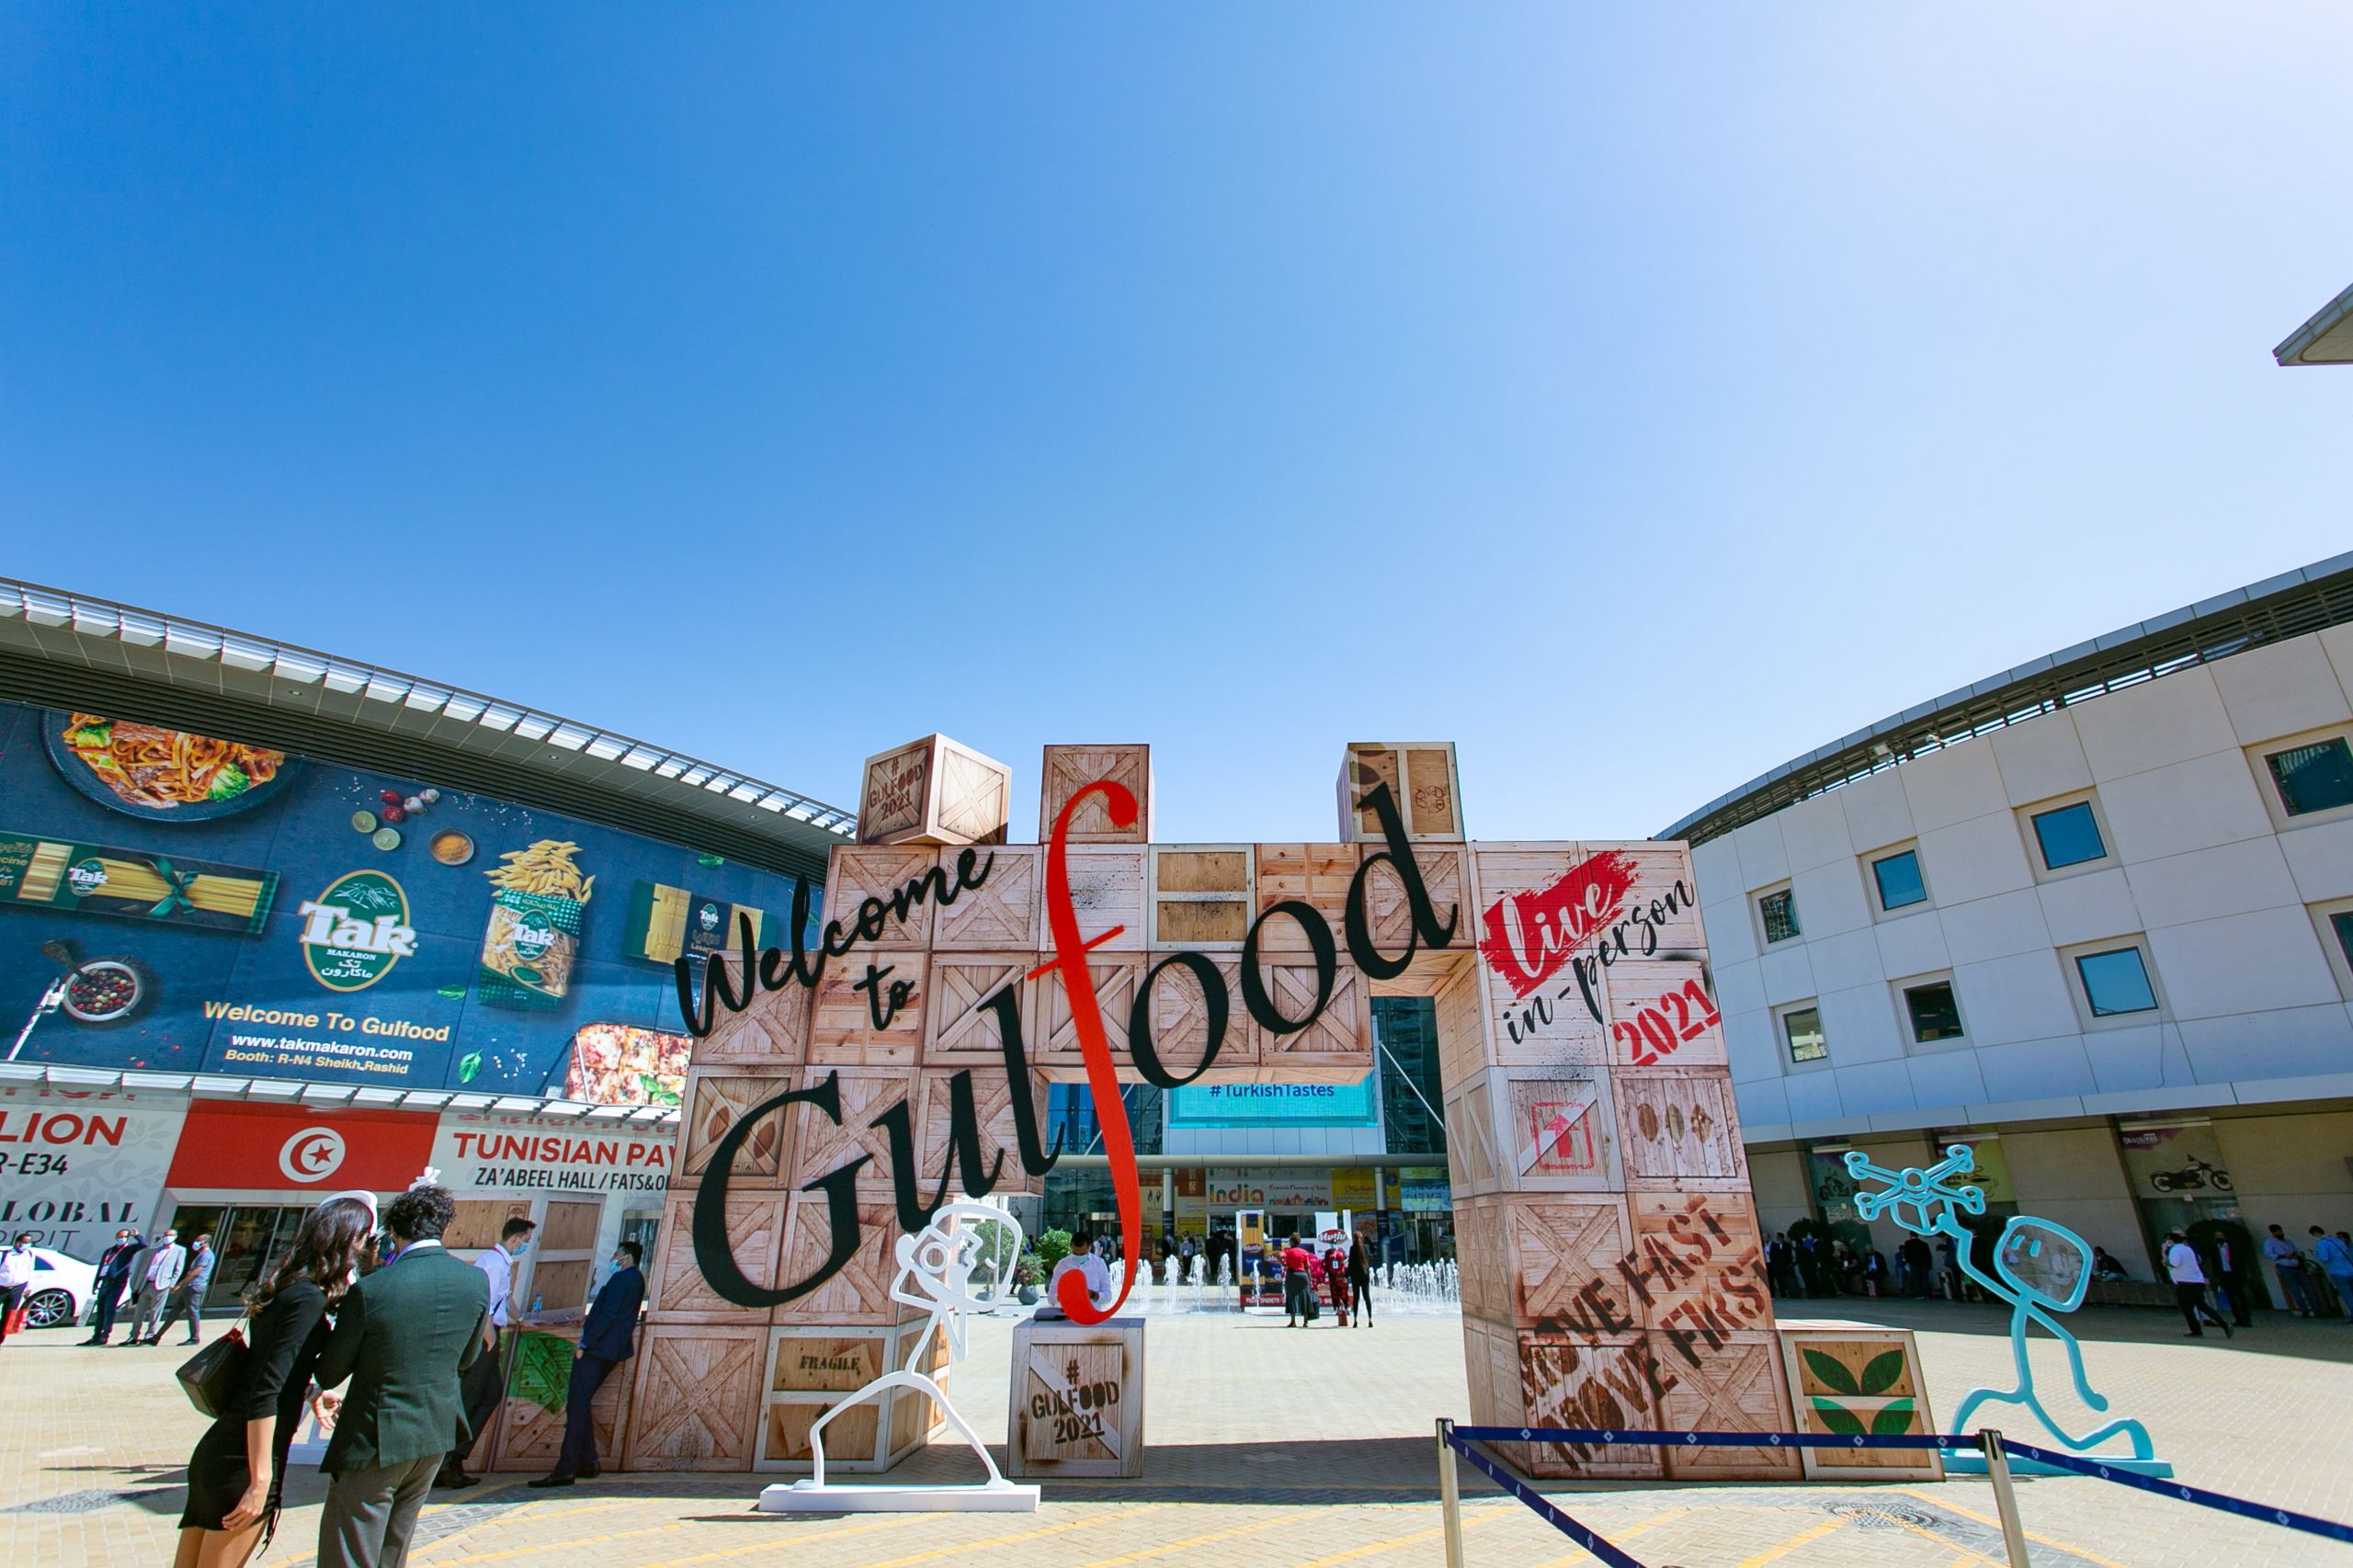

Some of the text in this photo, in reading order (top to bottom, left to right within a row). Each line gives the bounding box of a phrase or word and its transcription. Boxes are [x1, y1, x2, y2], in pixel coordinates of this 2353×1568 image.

[881, 789, 912, 821] 2021
[68, 867, 108, 884] Tak
[298, 901, 419, 957] Tak
[699, 910, 719, 924] Tak
[511, 923, 555, 946] Tak
[675, 847, 995, 1038] Welcome
[326, 949, 377, 960] MAKARON
[1503, 879, 1695, 1045] in-person
[853, 964, 915, 1030] to
[203, 1000, 450, 1042] Welcome To Gulfood
[1613, 978, 1721, 1066] 2021
[224, 1050, 408, 1074] Booth: R-N4 Sheikh Rashid
[232, 1033, 413, 1061] www.takmakaron.com
[692, 779, 1459, 1326] Gulfood
[453, 1132, 619, 1165] TUNISIAN
[558, 1170, 597, 1189] HALL
[598, 1172, 608, 1189] /
[1210, 1184, 1265, 1203] India
[1616, 1194, 1732, 1309] FAST
[1659, 1244, 1769, 1369] FIRST
[799, 1355, 860, 1370] FRAGILE
[1031, 1381, 1120, 1419] GULFOOD
[1053, 1412, 1105, 1444] 2021
